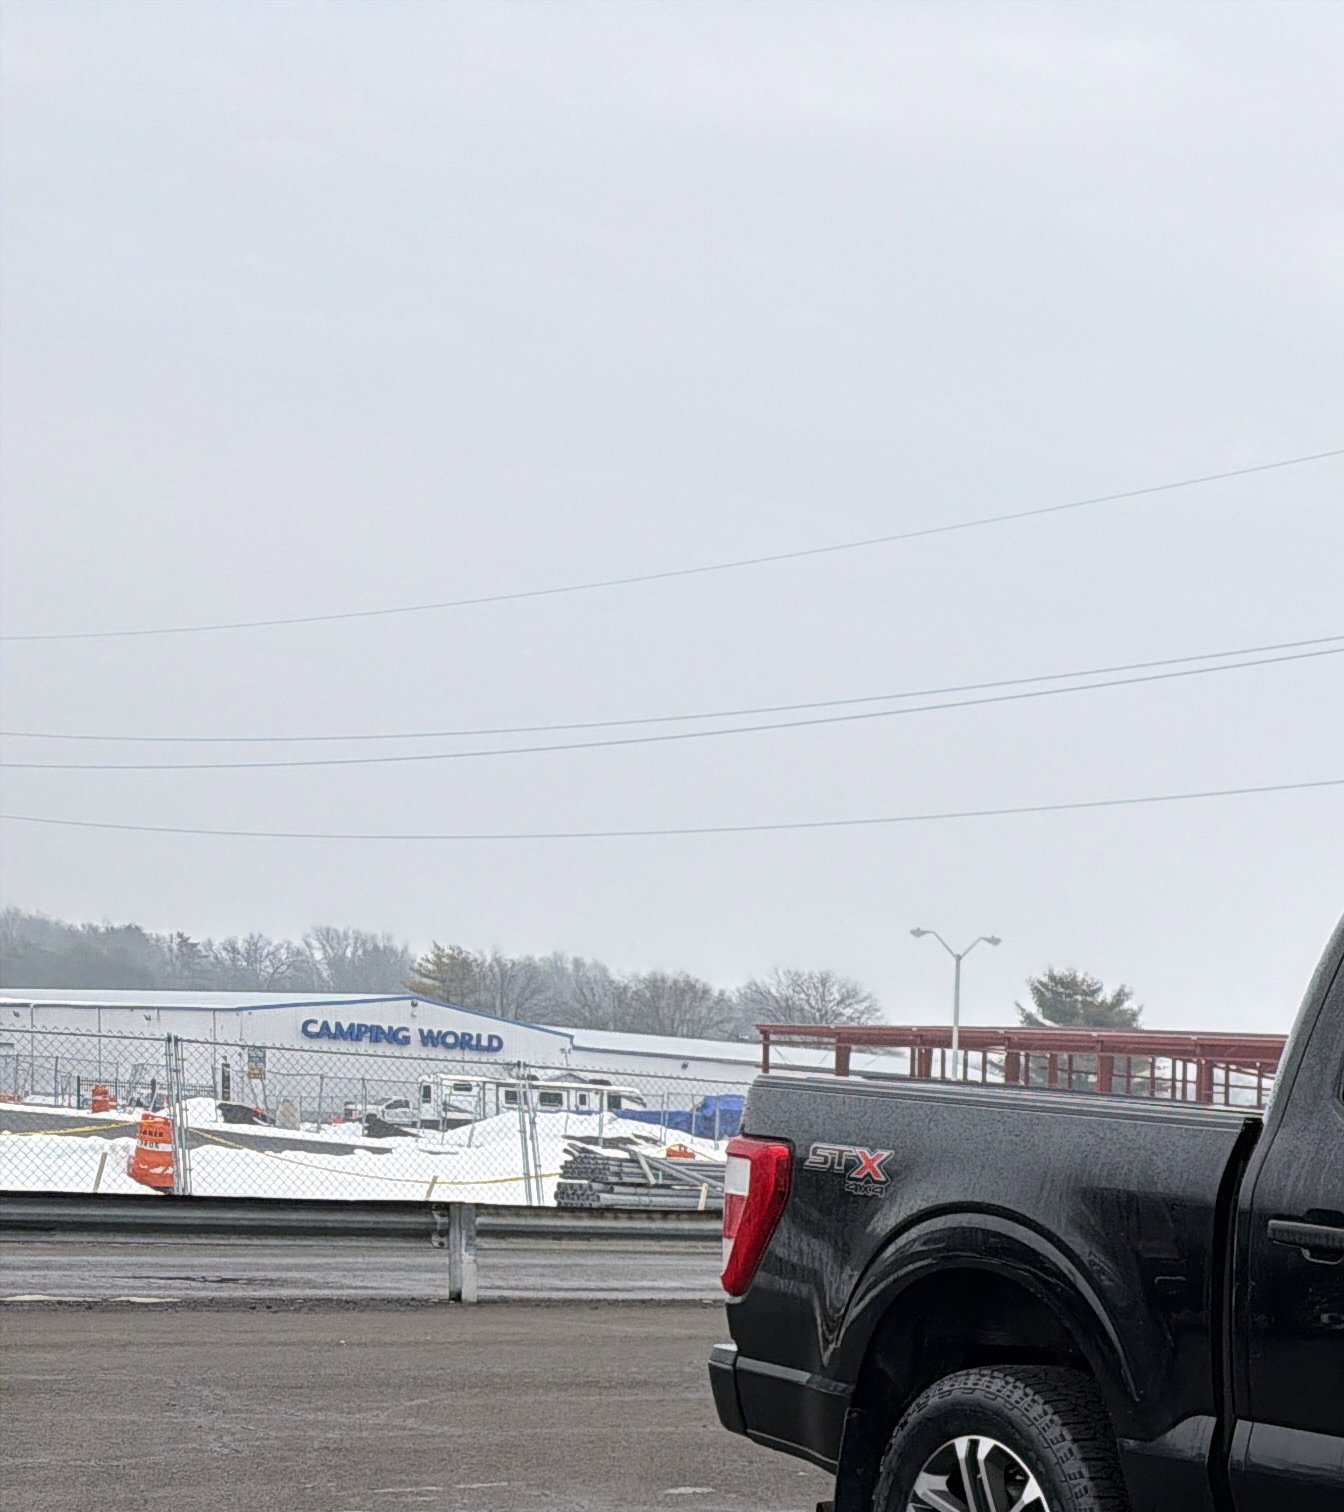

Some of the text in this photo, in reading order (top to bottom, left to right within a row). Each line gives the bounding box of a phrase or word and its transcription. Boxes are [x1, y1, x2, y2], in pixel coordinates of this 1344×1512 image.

[301, 1018, 504, 1052] CAMPING WORLD
[803, 1142, 895, 1185] STX
